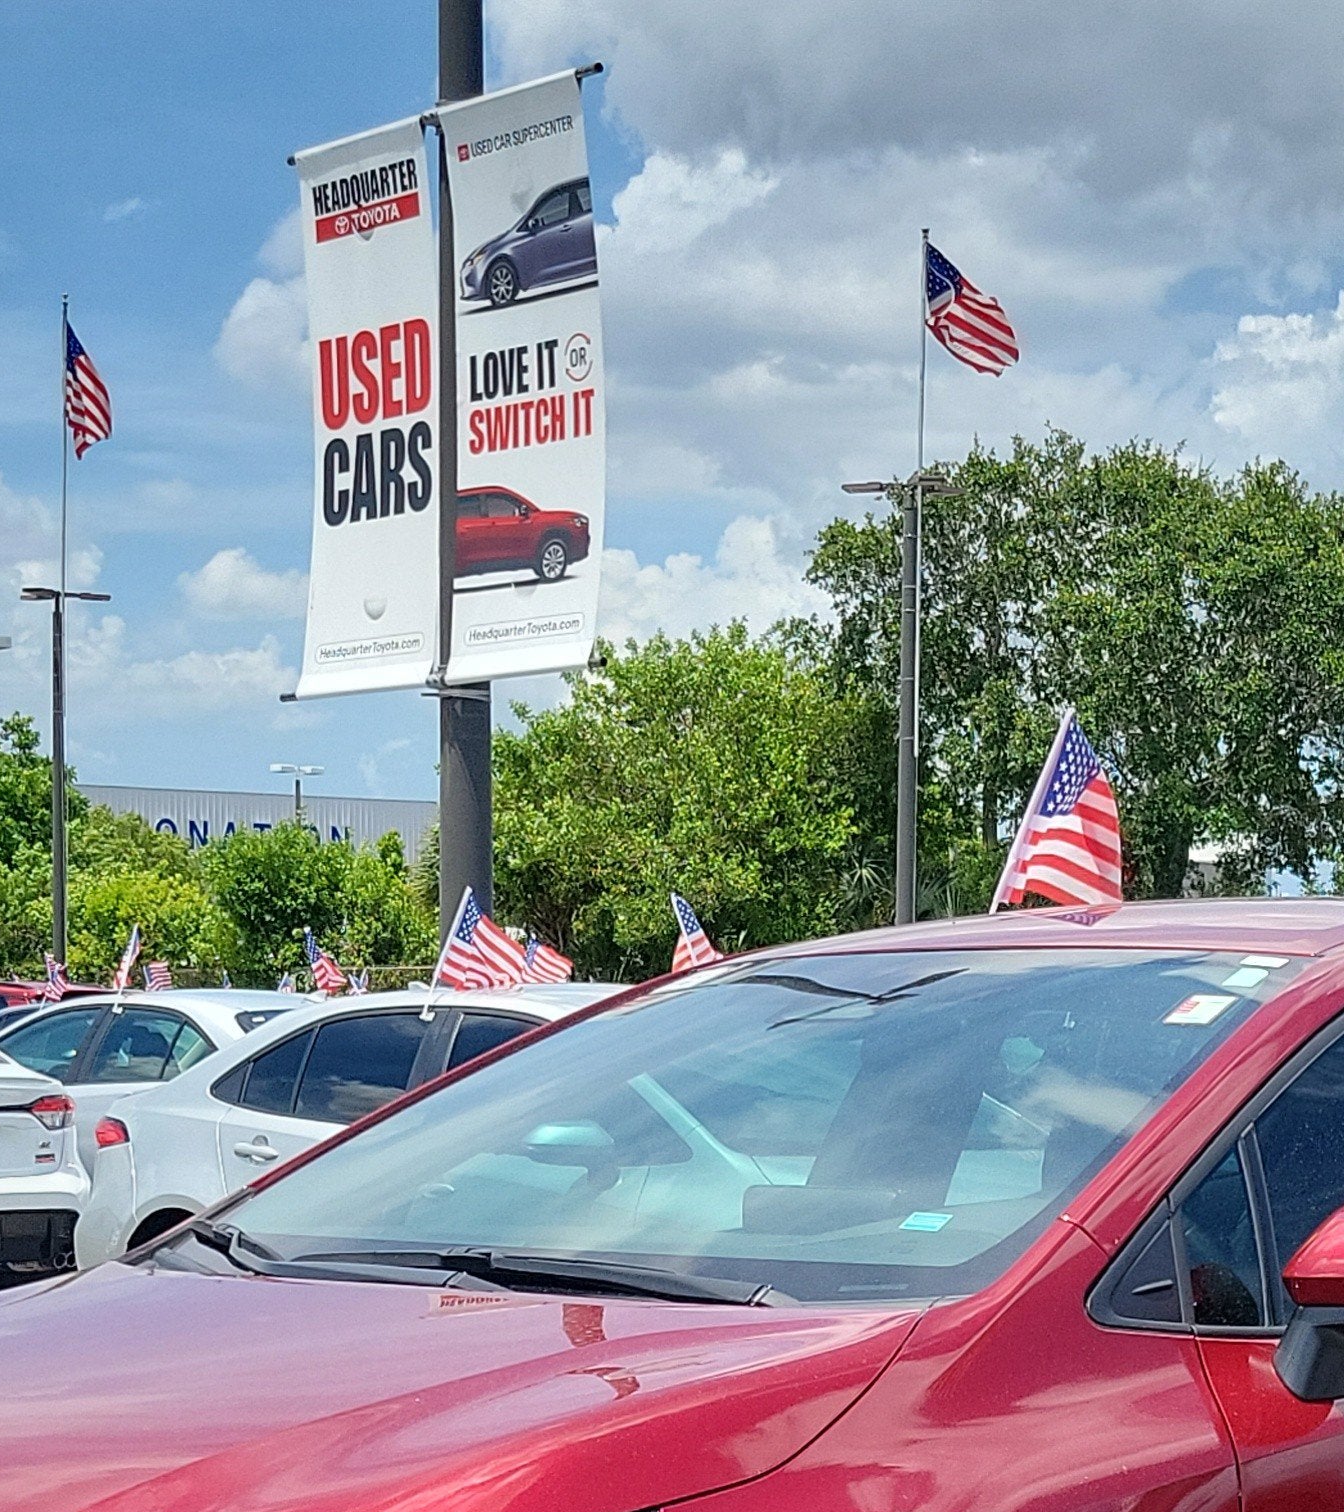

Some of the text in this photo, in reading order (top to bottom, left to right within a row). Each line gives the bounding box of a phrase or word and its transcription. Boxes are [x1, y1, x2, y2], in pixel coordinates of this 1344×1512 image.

[470, 115, 574, 158] USED CAR SUPERCENTER
[312, 158, 419, 216] HEADQUARTER
[351, 203, 401, 231] TOYOTA
[319, 318, 431, 430] USED
[470, 339, 588, 402] LOVE IT OR
[469, 388, 595, 455] SWITCH IT
[323, 421, 432, 527] CARS
[319, 638, 421, 659] HeadquarterToyota.com
[467, 619, 581, 643] HeadquarterToyota.com
